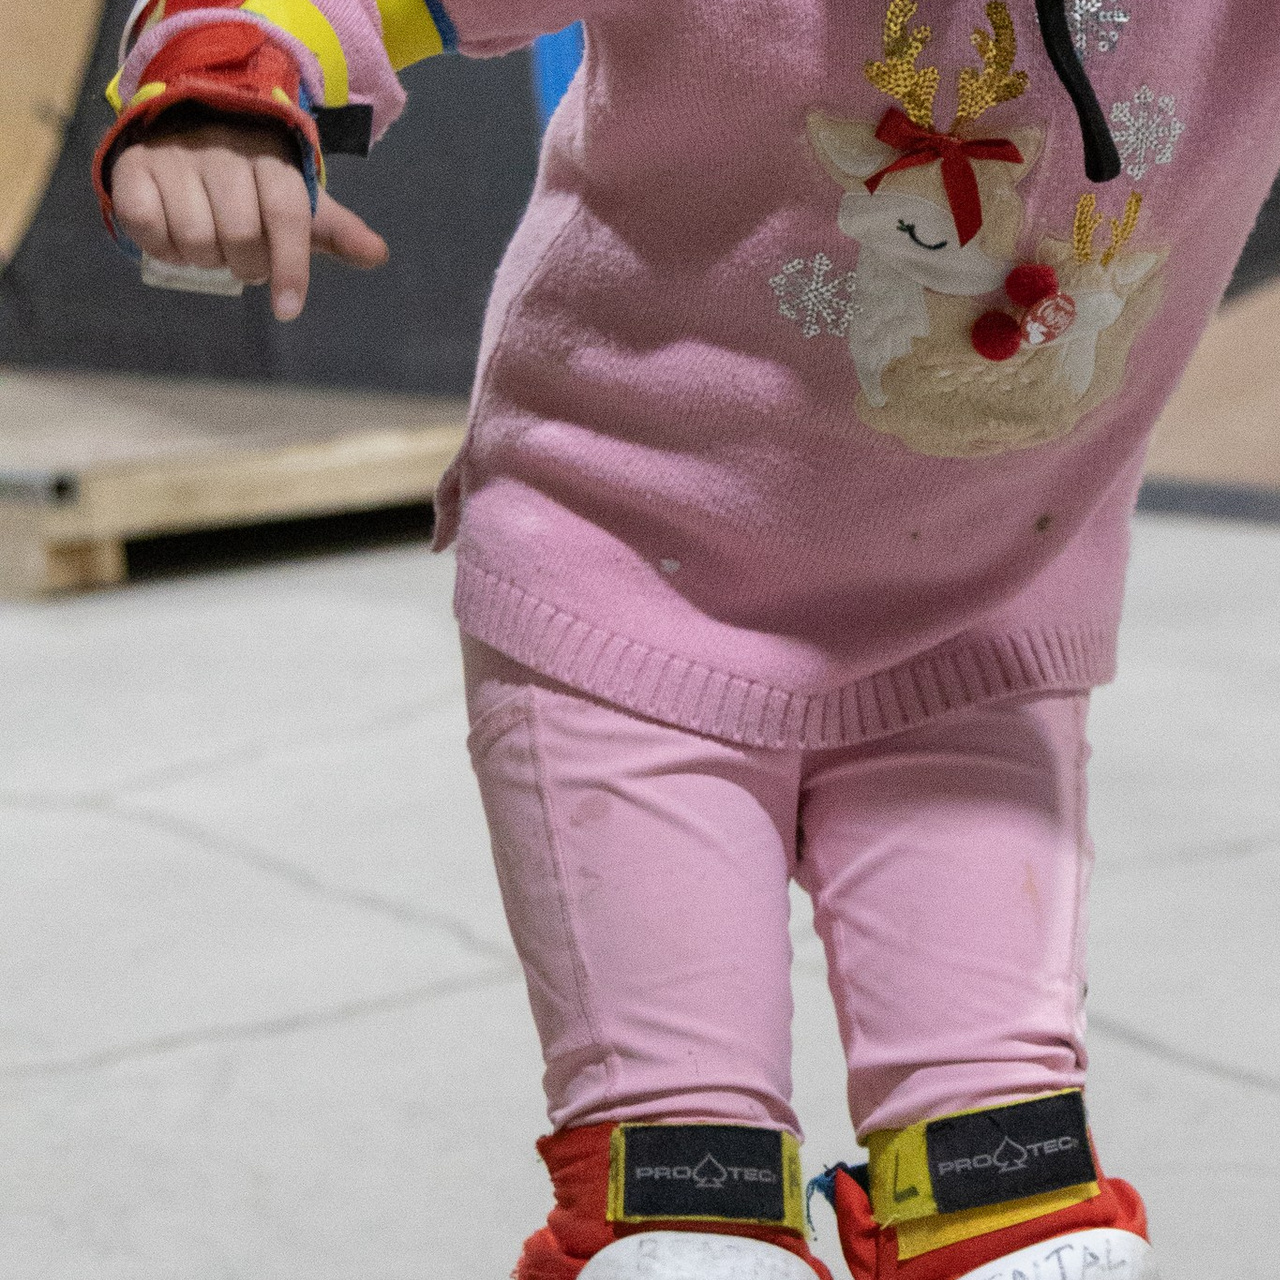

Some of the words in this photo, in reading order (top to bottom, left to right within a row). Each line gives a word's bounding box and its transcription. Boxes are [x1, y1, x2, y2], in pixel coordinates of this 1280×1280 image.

[937, 1154, 993, 1176] PRO
[1026, 1136, 1073, 1157] TEC
[635, 1166, 692, 1180] PRO
[727, 1167, 774, 1182] TEC
